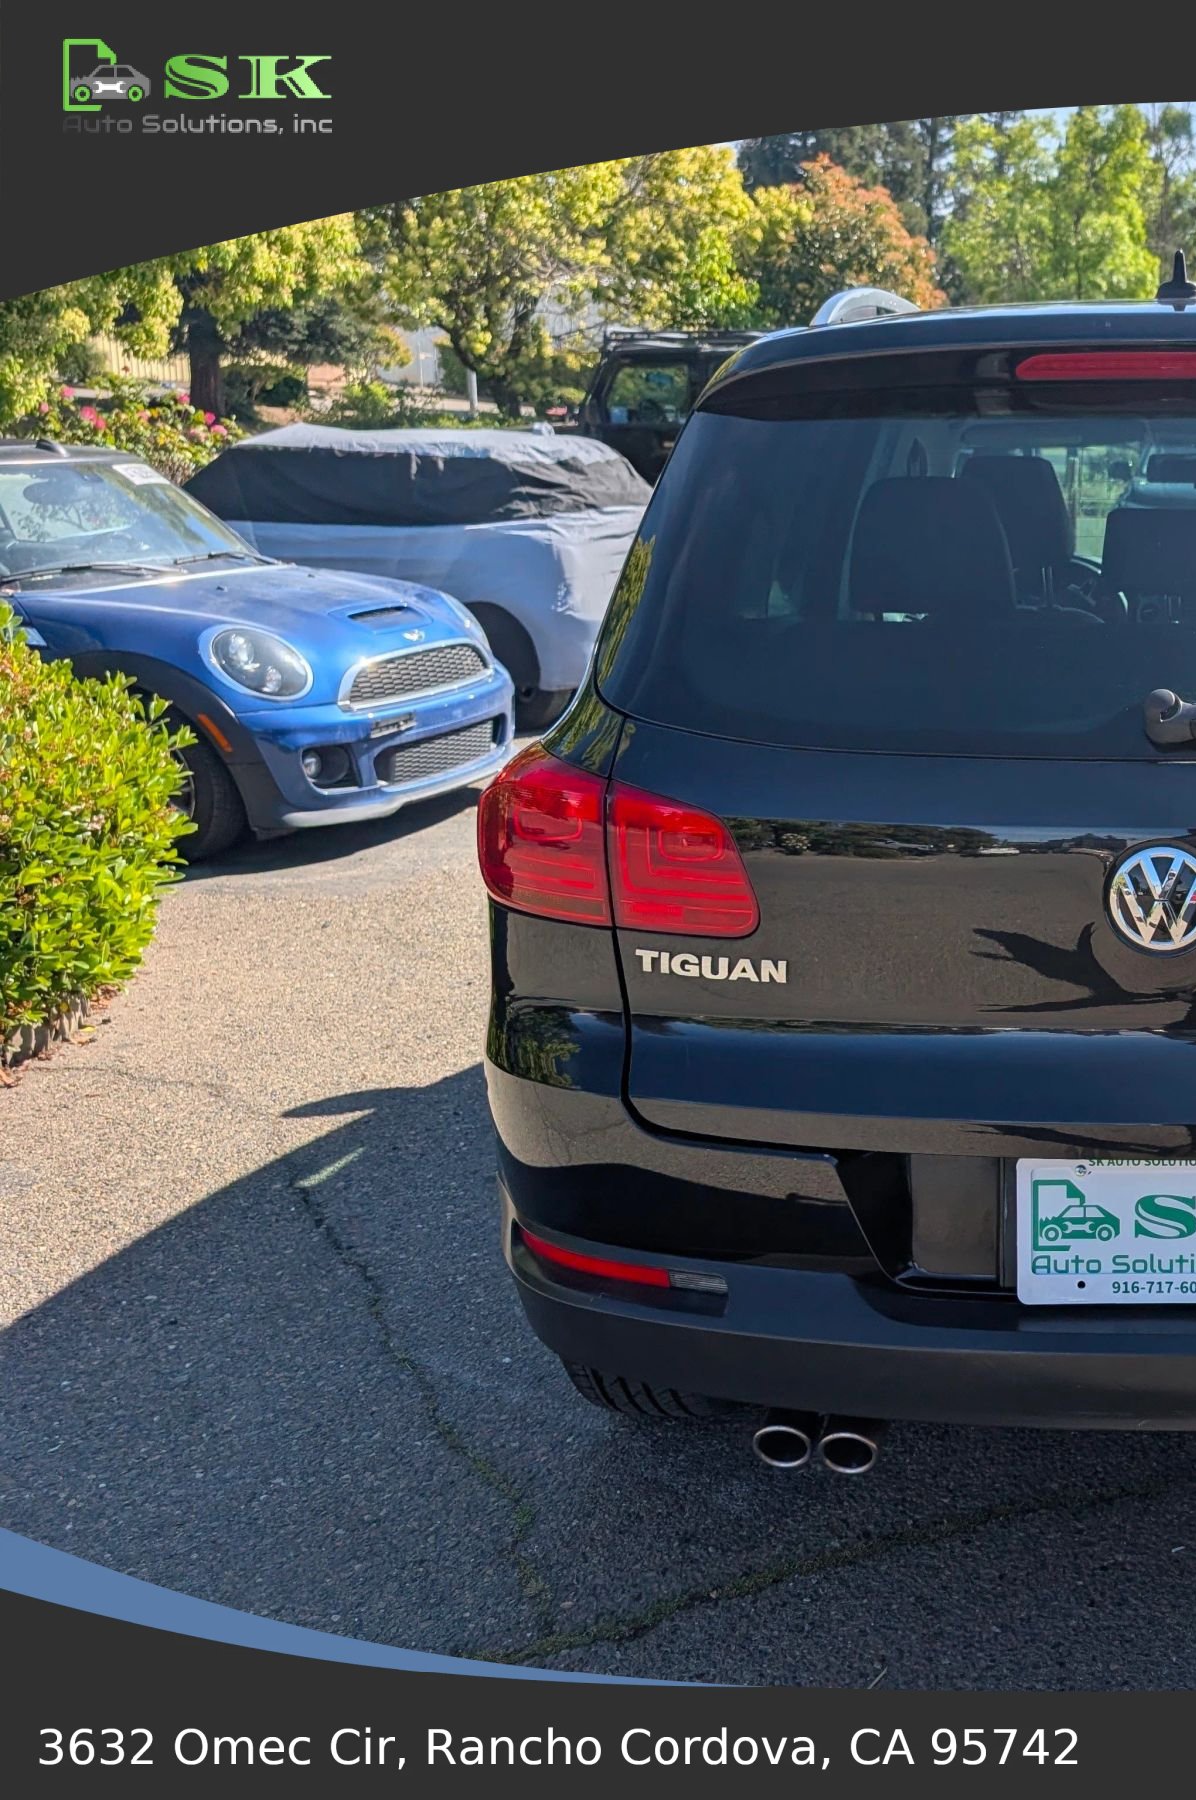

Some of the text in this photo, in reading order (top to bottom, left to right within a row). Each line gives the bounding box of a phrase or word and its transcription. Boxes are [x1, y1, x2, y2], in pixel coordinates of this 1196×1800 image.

[634, 948, 788, 984] TIGUAN
[1106, 1158, 1141, 1168] AUTO
[1031, 1254, 1102, 1275] Auto
